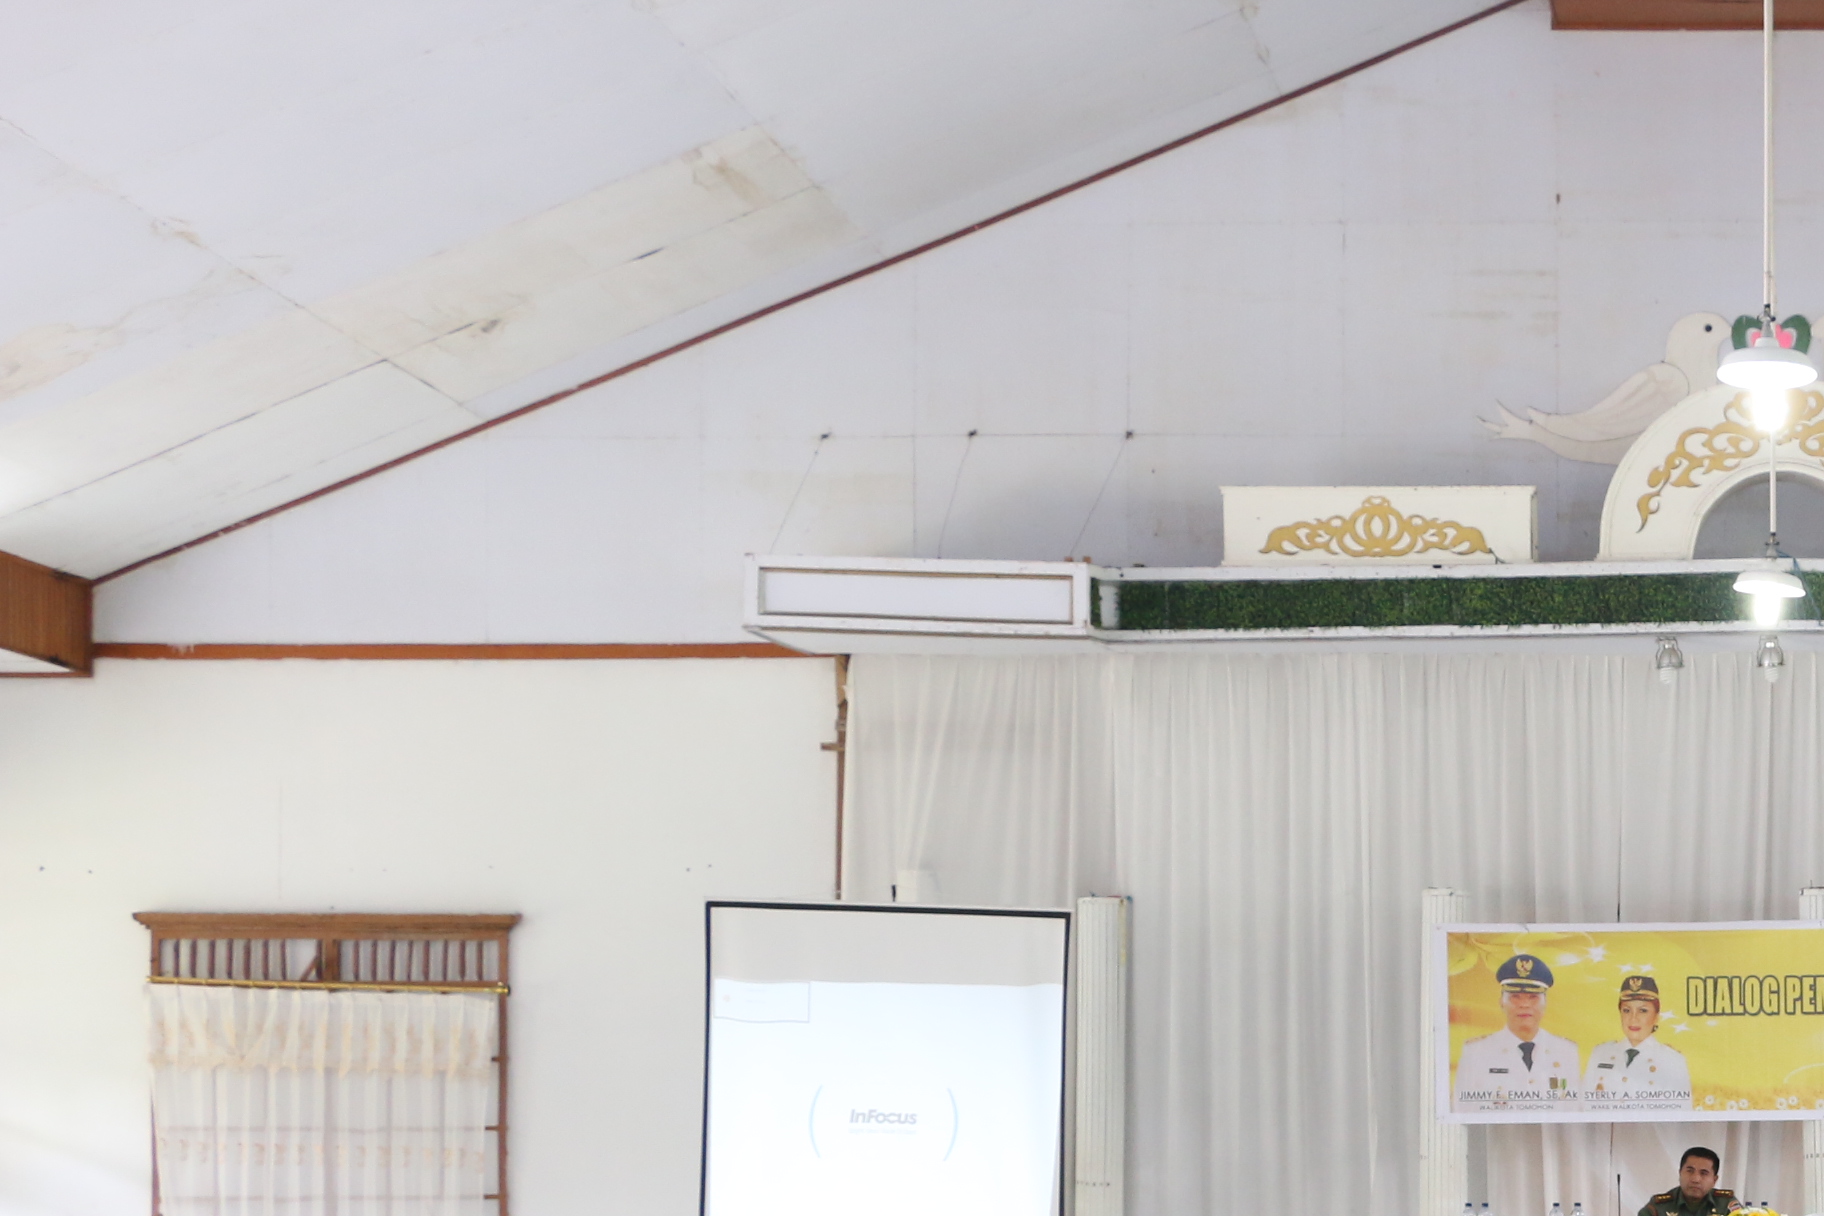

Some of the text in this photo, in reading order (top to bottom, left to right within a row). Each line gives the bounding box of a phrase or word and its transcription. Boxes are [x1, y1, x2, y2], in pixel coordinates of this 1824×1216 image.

[1686, 975, 1780, 1016] DIALOG
[1459, 1090, 1492, 1100] JIMMY
[1507, 1090, 1543, 1100] EMAN,
[1564, 1090, 1578, 1099] Ak
[1584, 1090, 1616, 1099] SYERLY
[1635, 1090, 1690, 1099] SOMPOTAN
[849, 1108, 918, 1125] InFocus
